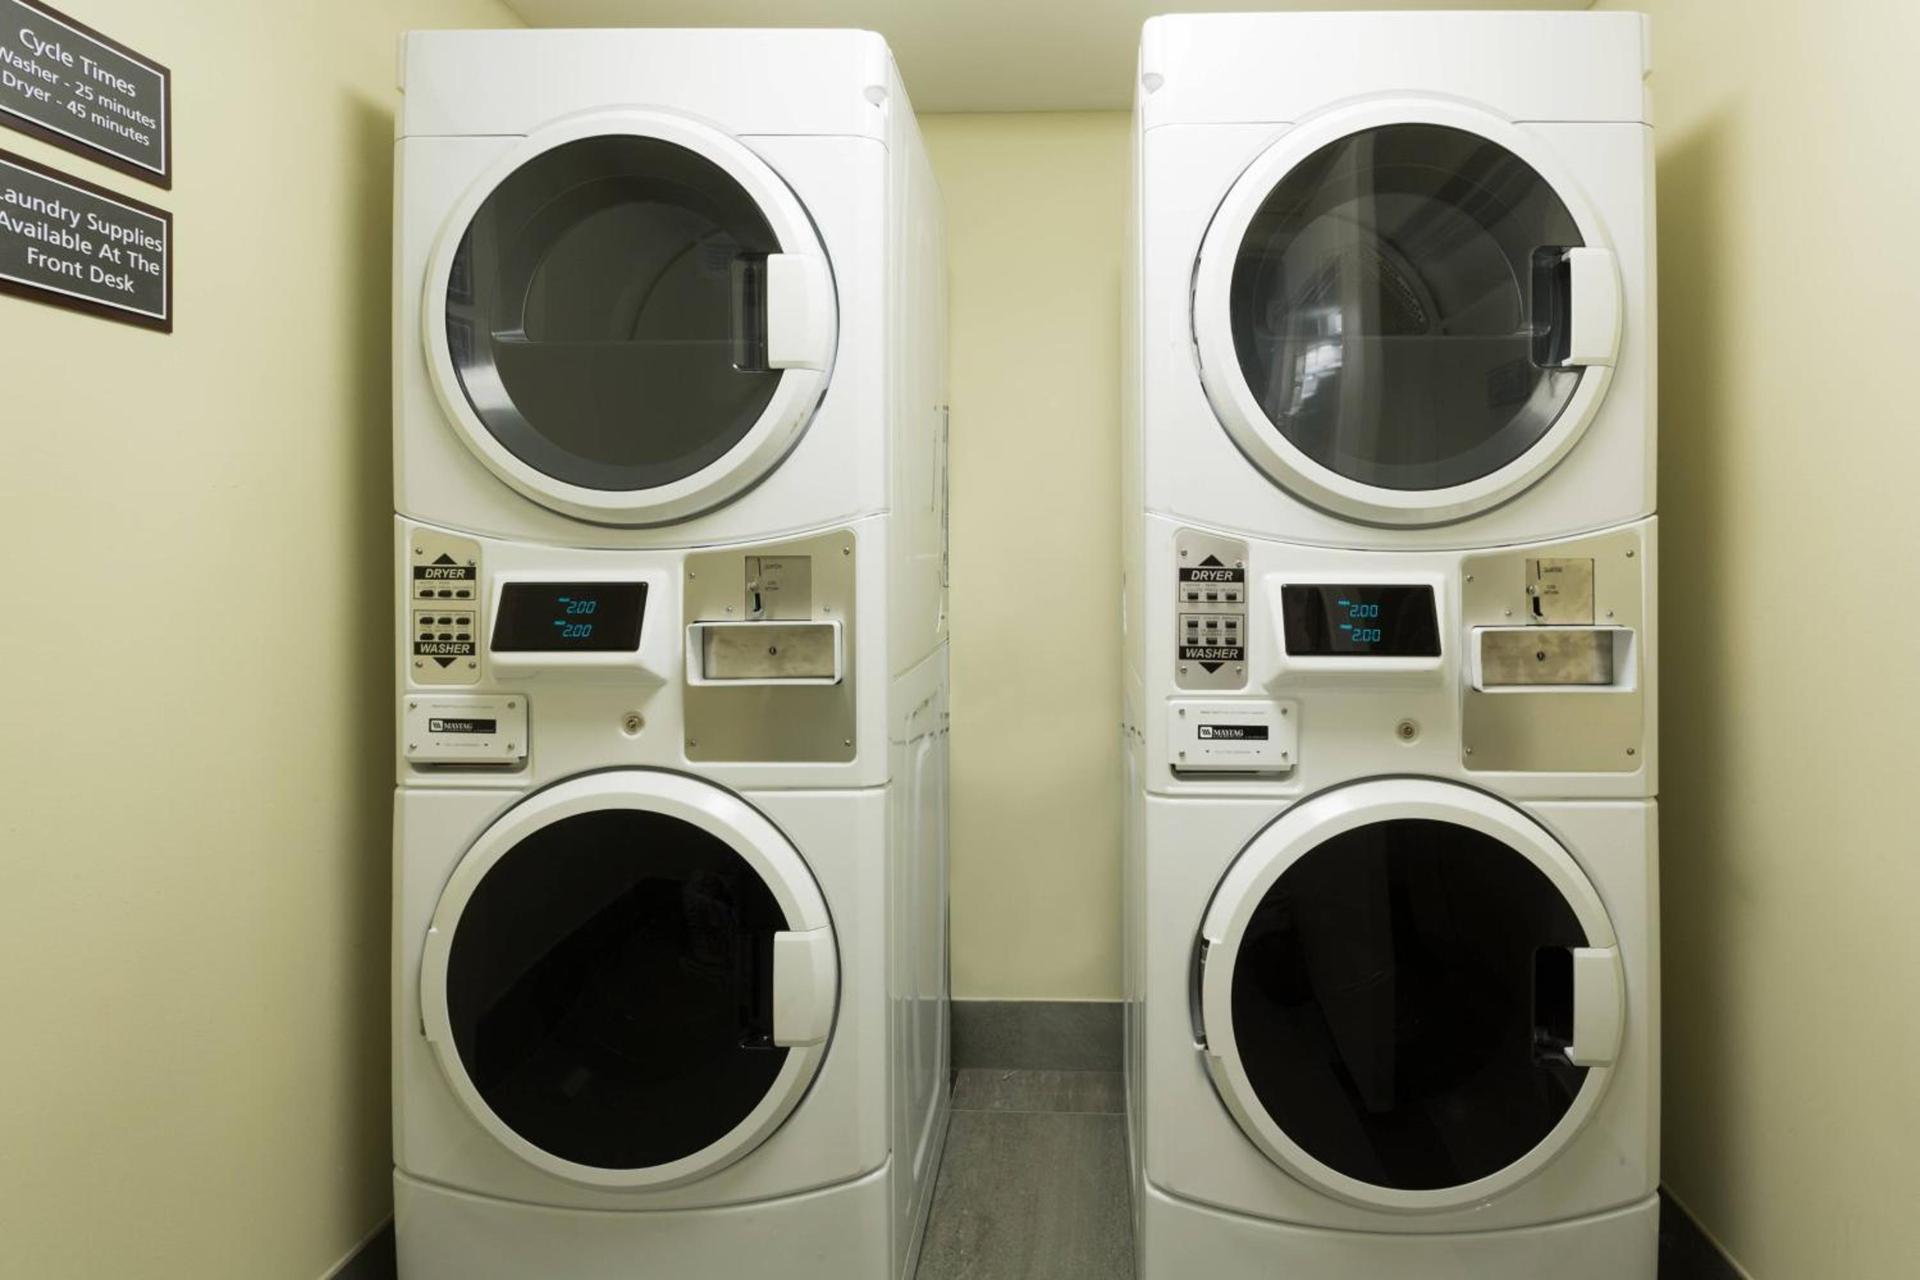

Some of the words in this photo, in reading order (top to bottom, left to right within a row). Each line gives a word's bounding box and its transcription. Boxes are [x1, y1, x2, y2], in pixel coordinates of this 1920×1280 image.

[19, 28, 74, 68] Cycle
[79, 55, 136, 97] Times
[2, 70, 51, 102] Dryer
[66, 101, 87, 118] 45
[91, 112, 150, 146] minutes
[75, 81, 94, 100] 25
[98, 95, 156, 129] minutes
[0, 188, 80, 228] aundry
[87, 212, 162, 252] Supplies
[0, 210, 92, 255] Available
[99, 243, 121, 264] At
[126, 250, 160, 275] The
[27, 246, 83, 279] Front
[90, 264, 135, 293] Desk
[425, 568, 466, 579] DRYER
[1191, 570, 1233, 580] DRYER
[566, 600, 597, 614] 2.00
[1350, 604, 1378, 618] 2.00
[562, 623, 592, 638] 2.00
[1352, 628, 1381, 643] 2.00
[420, 643, 471, 654] WASHER
[1185, 648, 1239, 659] WASHER
